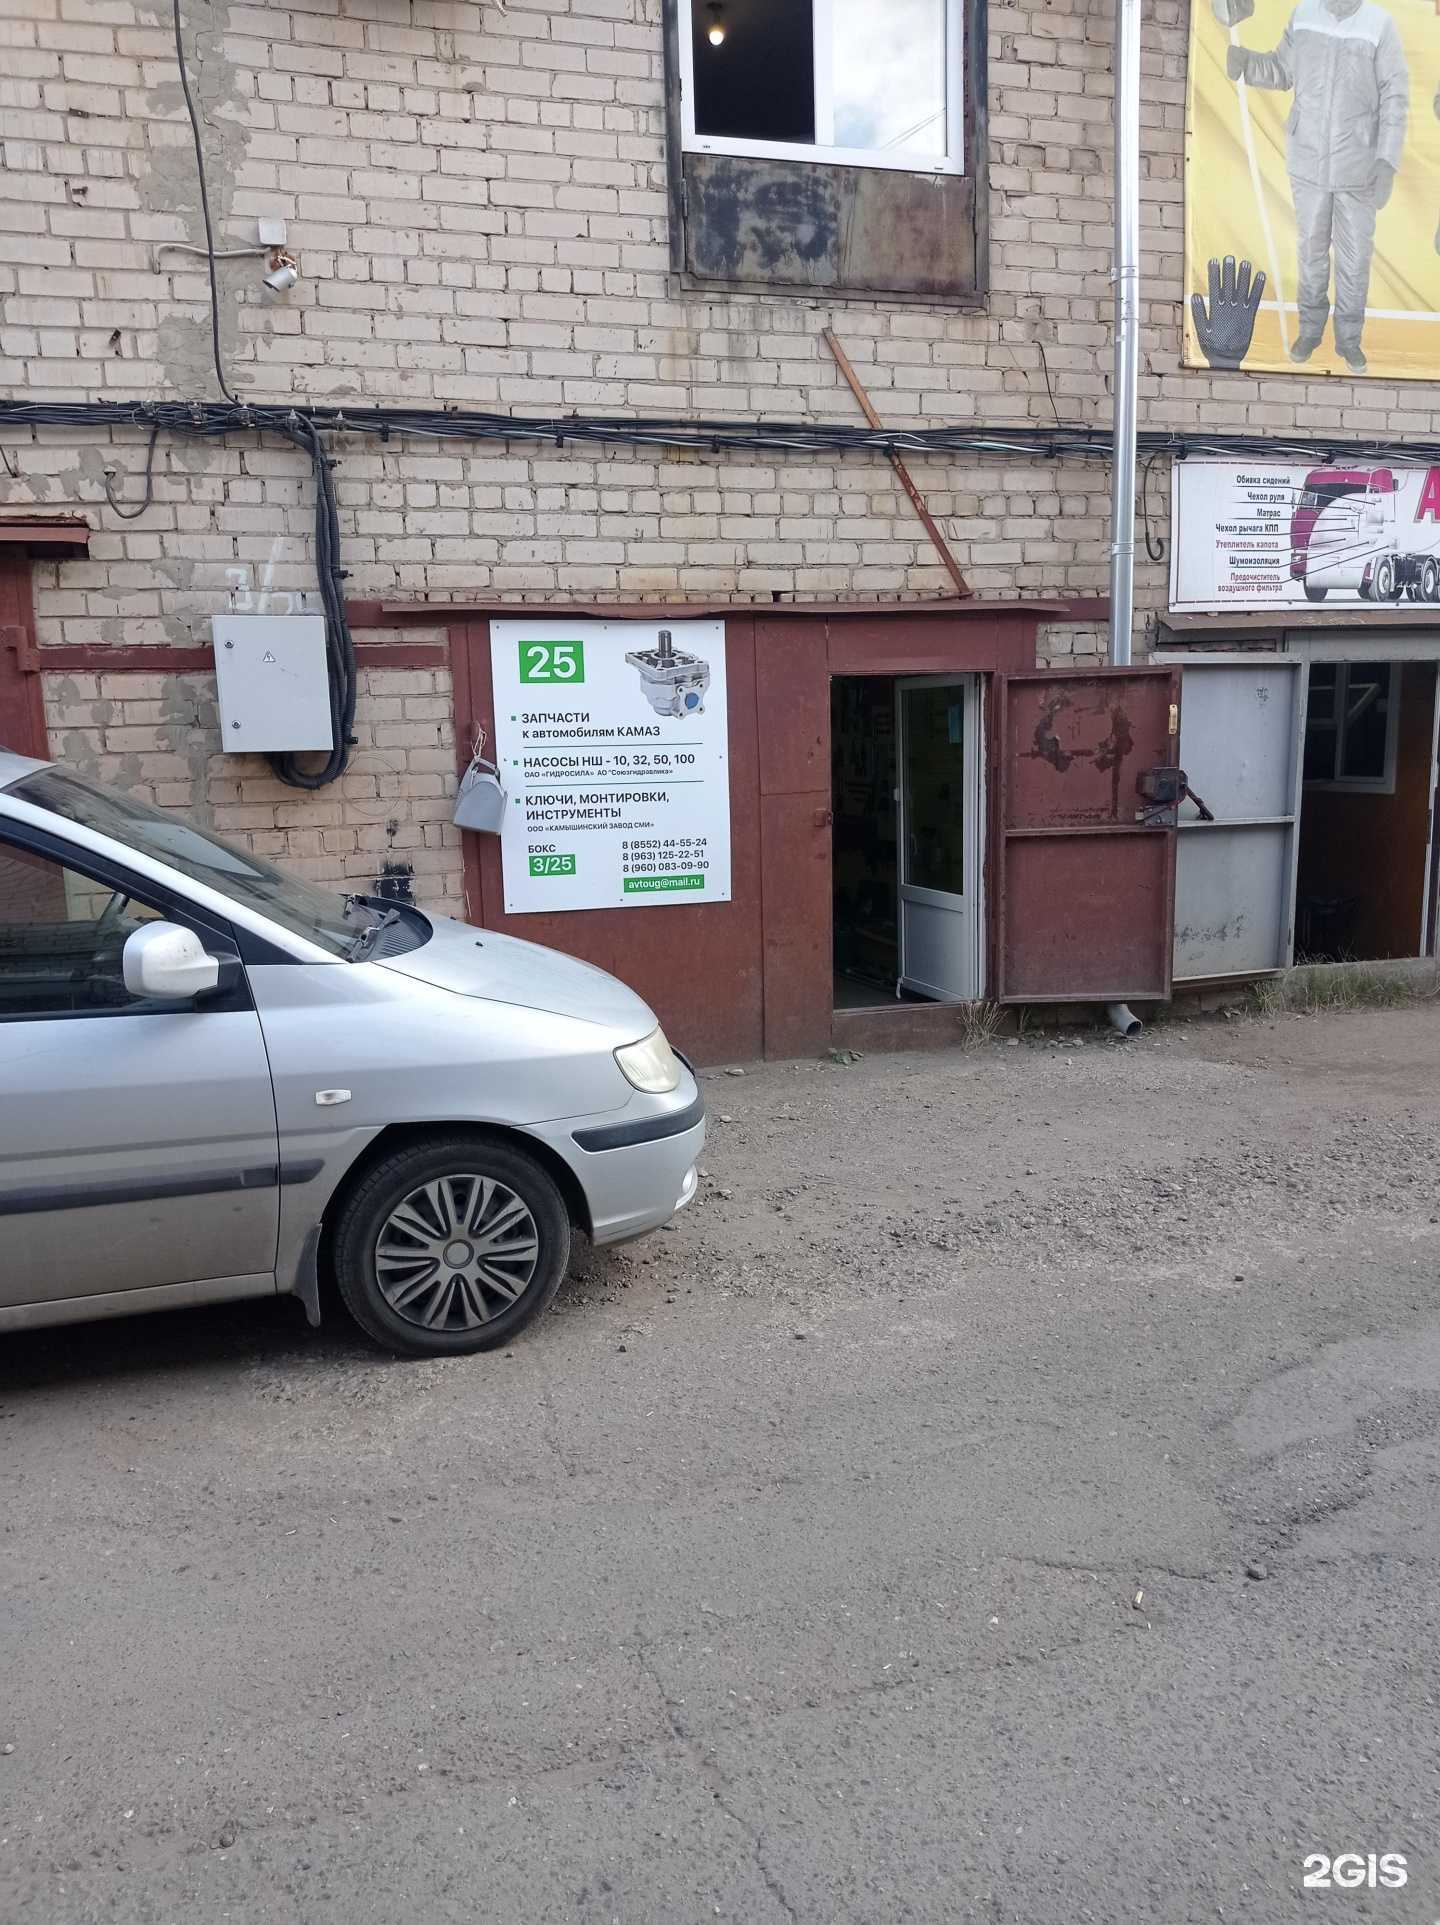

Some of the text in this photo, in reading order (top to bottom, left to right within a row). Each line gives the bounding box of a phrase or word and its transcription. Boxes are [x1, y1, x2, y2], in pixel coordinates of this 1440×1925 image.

[1237, 476, 1290, 485] Обивка сидений
[1248, 492, 1284, 501] Чехол руля
[1257, 509, 1280, 517] Матрас
[1216, 524, 1279, 533] Чехол рычага КПП
[1216, 540, 1254, 548] Утеплитель
[1230, 556, 1280, 566] Шумоизоляция
[1231, 573, 1280, 581] Предочиститель
[1218, 583, 1282, 592] воздушного фильтра
[526, 646, 576, 678] 25
[522, 713, 590, 723] ЗАПЧАСТИ
[523, 727, 660, 738] к автомобилям КАМАЗ
[524, 757, 579, 767] НАСОСЫ
[582, 756, 603, 766] НШ
[615, 756, 630, 766] 10,
[633, 755, 651, 766] 32,
[654, 755, 671, 765] 50,
[674, 754, 695, 764] 100
[526, 792, 669, 806] КЛЮЧИ, МОНТИРОВКИ,
[527, 808, 621, 820] ИНСТРУМЕНТЫ
[528, 844, 556, 853] БОКС
[622, 839, 707, 849] 8 (8552) 44-55-24
[623, 850, 704, 861] 8 (963) 125-22-51
[533, 858, 572, 873] 3/25
[631, 863, 656, 873] (960)
[658, 861, 709, 871] 083-09-90
[629, 877, 700, 889] avtoug@mail.ru
